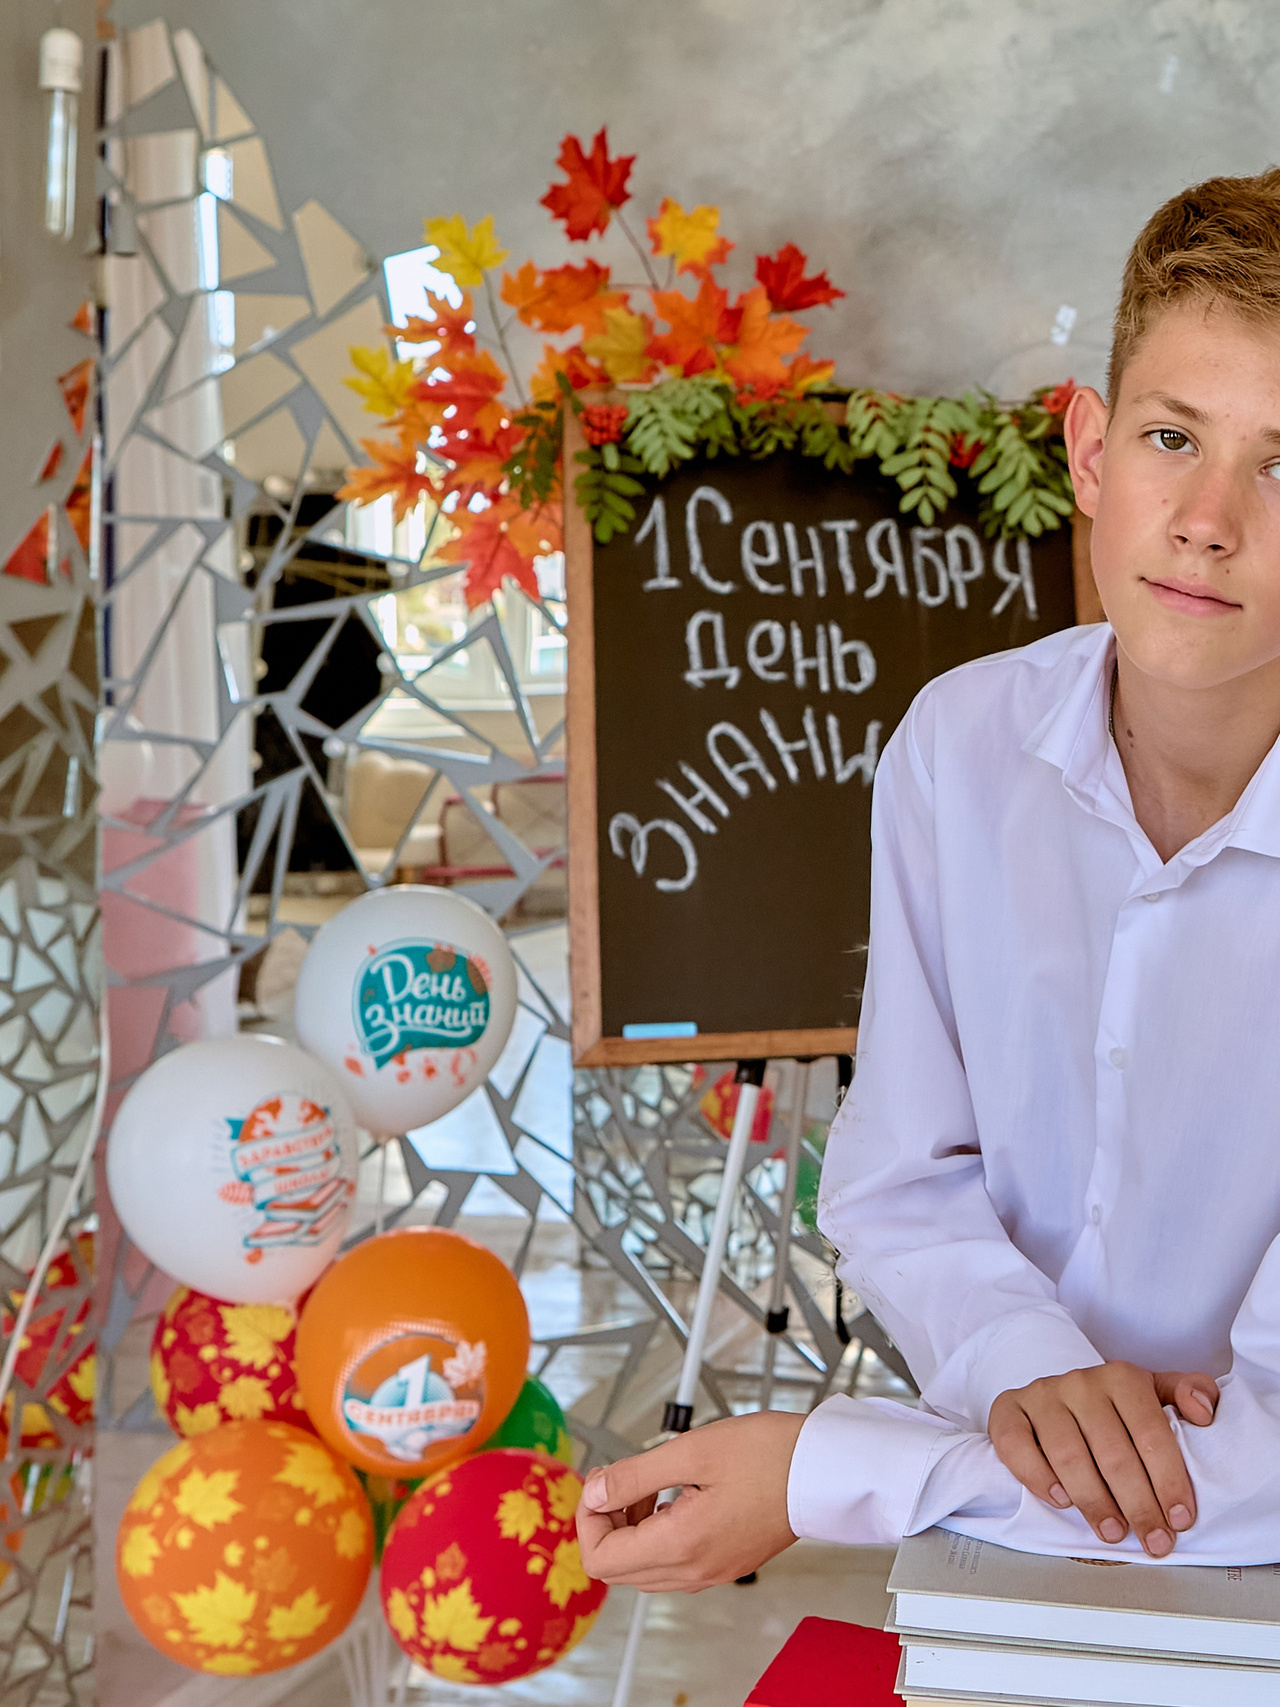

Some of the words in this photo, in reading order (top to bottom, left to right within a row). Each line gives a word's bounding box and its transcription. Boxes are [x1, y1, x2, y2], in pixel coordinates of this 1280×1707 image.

[684, 609, 877, 694] День
[608, 706, 882, 893] ЗНАНИ
[369, 953, 467, 1005] День
[397, 1353, 432, 1410] 1
